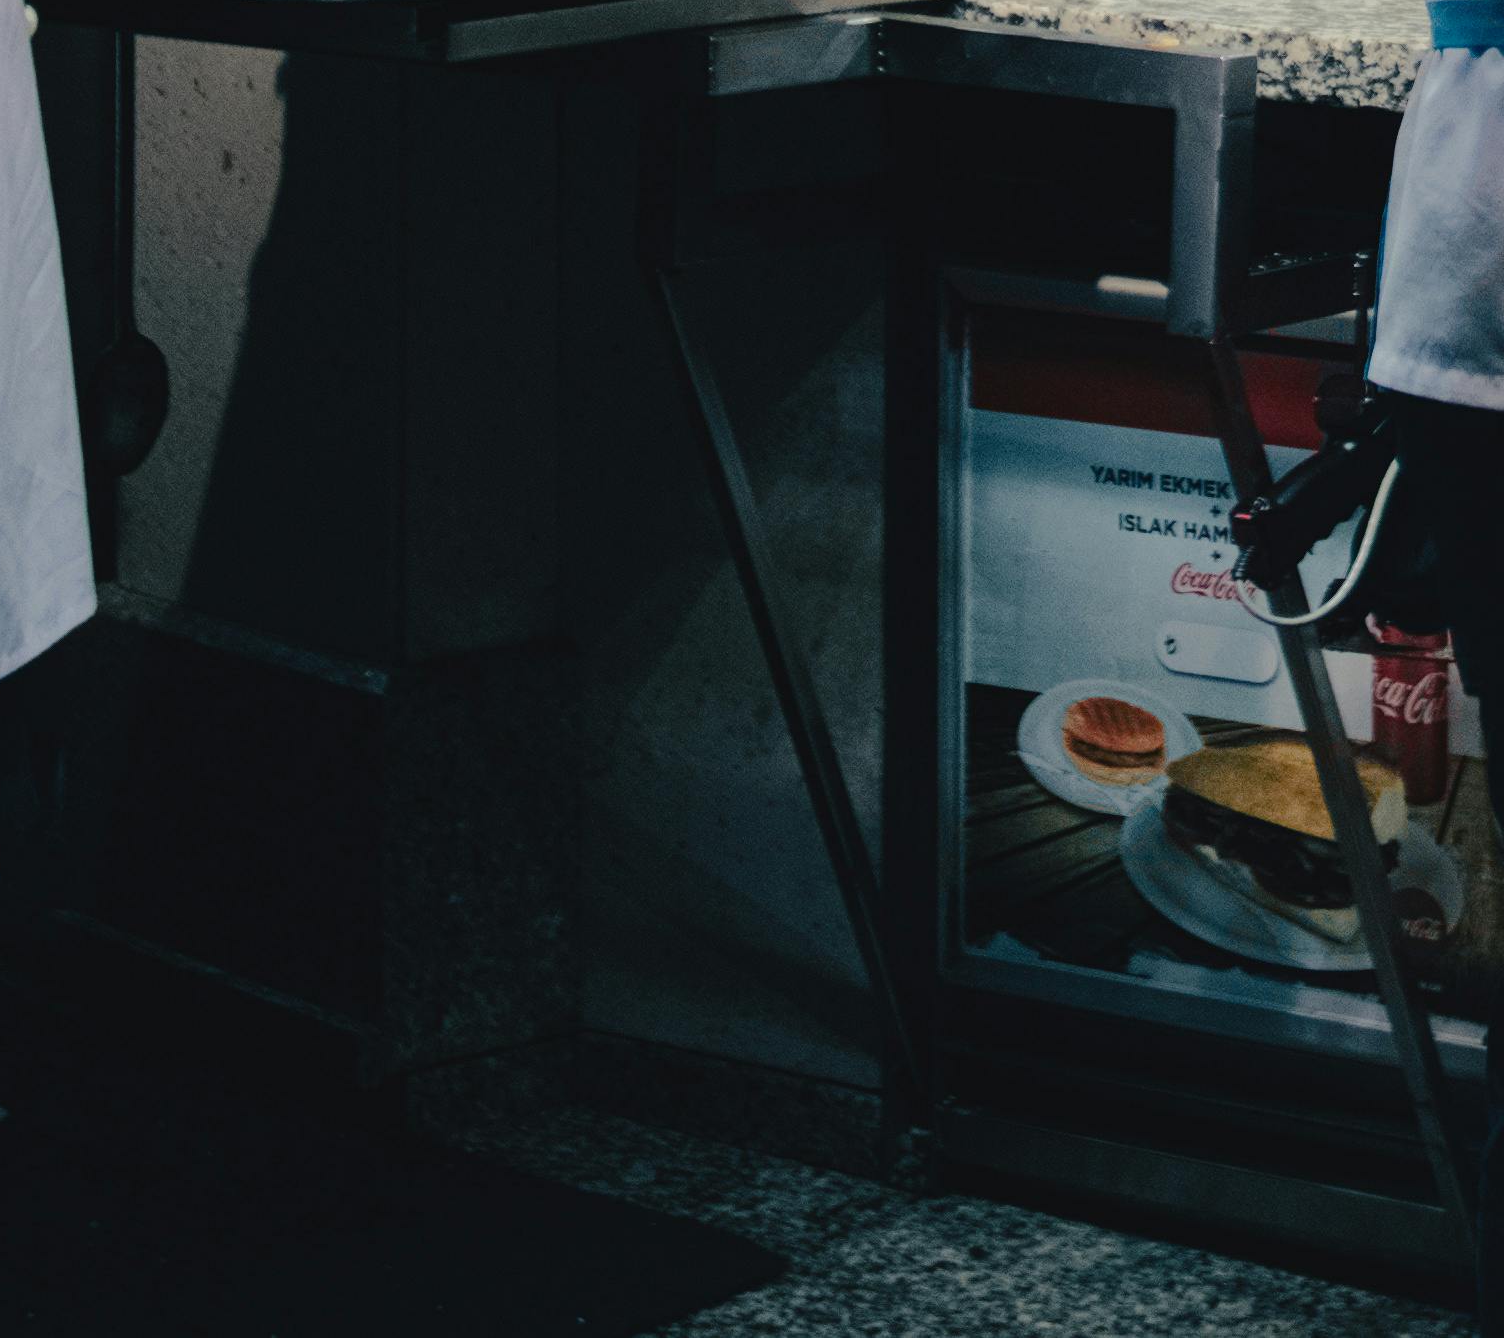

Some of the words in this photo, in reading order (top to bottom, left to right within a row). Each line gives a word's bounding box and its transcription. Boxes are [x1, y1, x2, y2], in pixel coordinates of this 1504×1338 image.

[1090, 465, 1154, 491] YARIM
[1160, 473, 1231, 499] EKMEK
[1118, 513, 1177, 537] ISLAK
[1184, 520, 1233, 543] HAM
